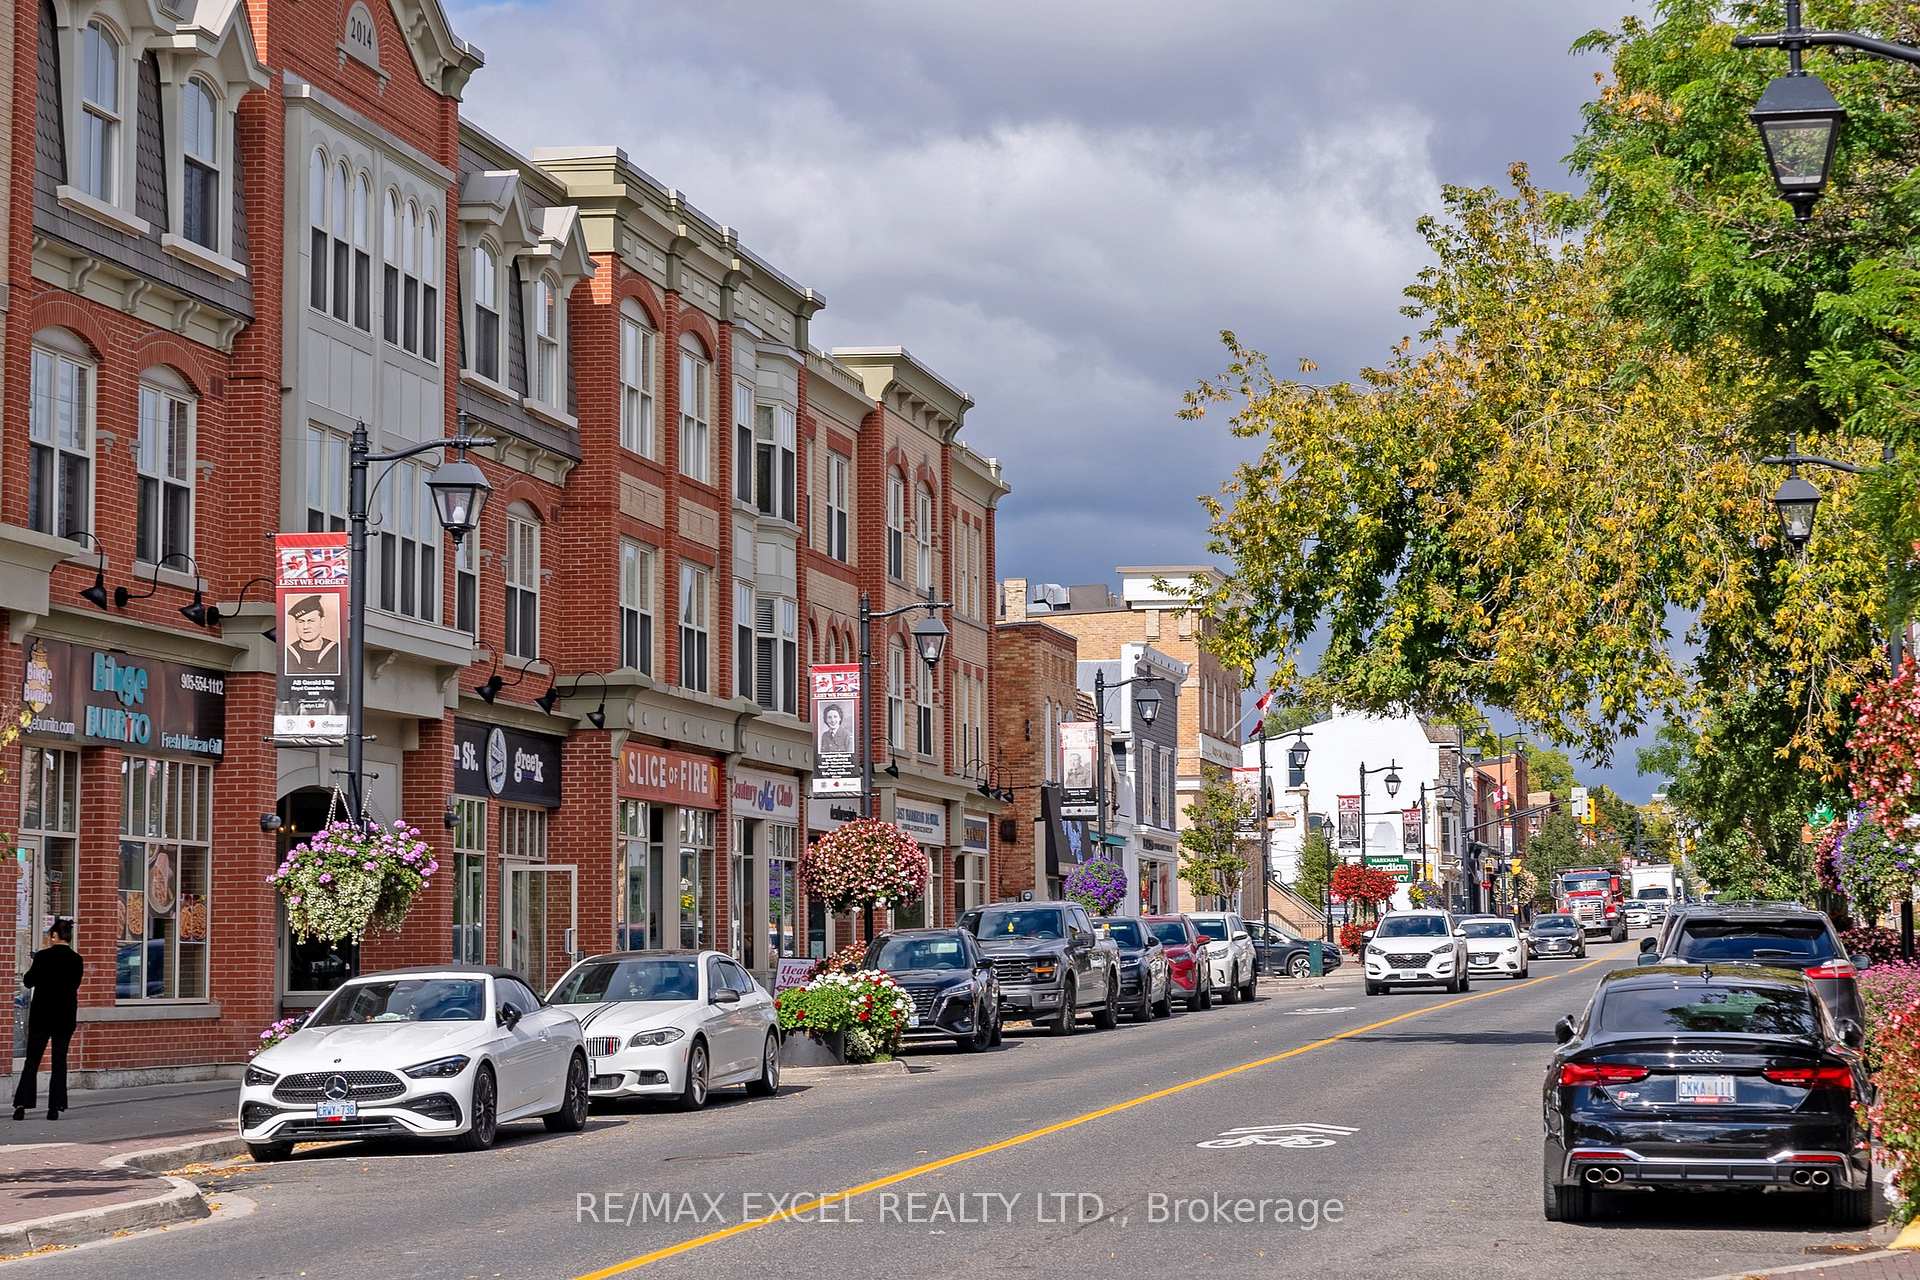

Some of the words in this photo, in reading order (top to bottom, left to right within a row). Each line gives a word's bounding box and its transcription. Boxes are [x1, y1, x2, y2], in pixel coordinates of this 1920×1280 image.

[351, 16, 372, 50] 2014
[26, 660, 53, 686] Binge
[92, 652, 148, 706] Binge
[181, 673, 223, 695] 905-554-1112
[23, 682, 53, 705] Burrito
[161, 731, 181, 749] Fresh
[181, 734, 208, 753] Mexican
[462, 741, 479, 771] St.
[514, 746, 544, 783] greek
[628, 751, 667, 788] SLICE
[680, 760, 709, 794] FIRE
[781, 975, 801, 986] Spa
